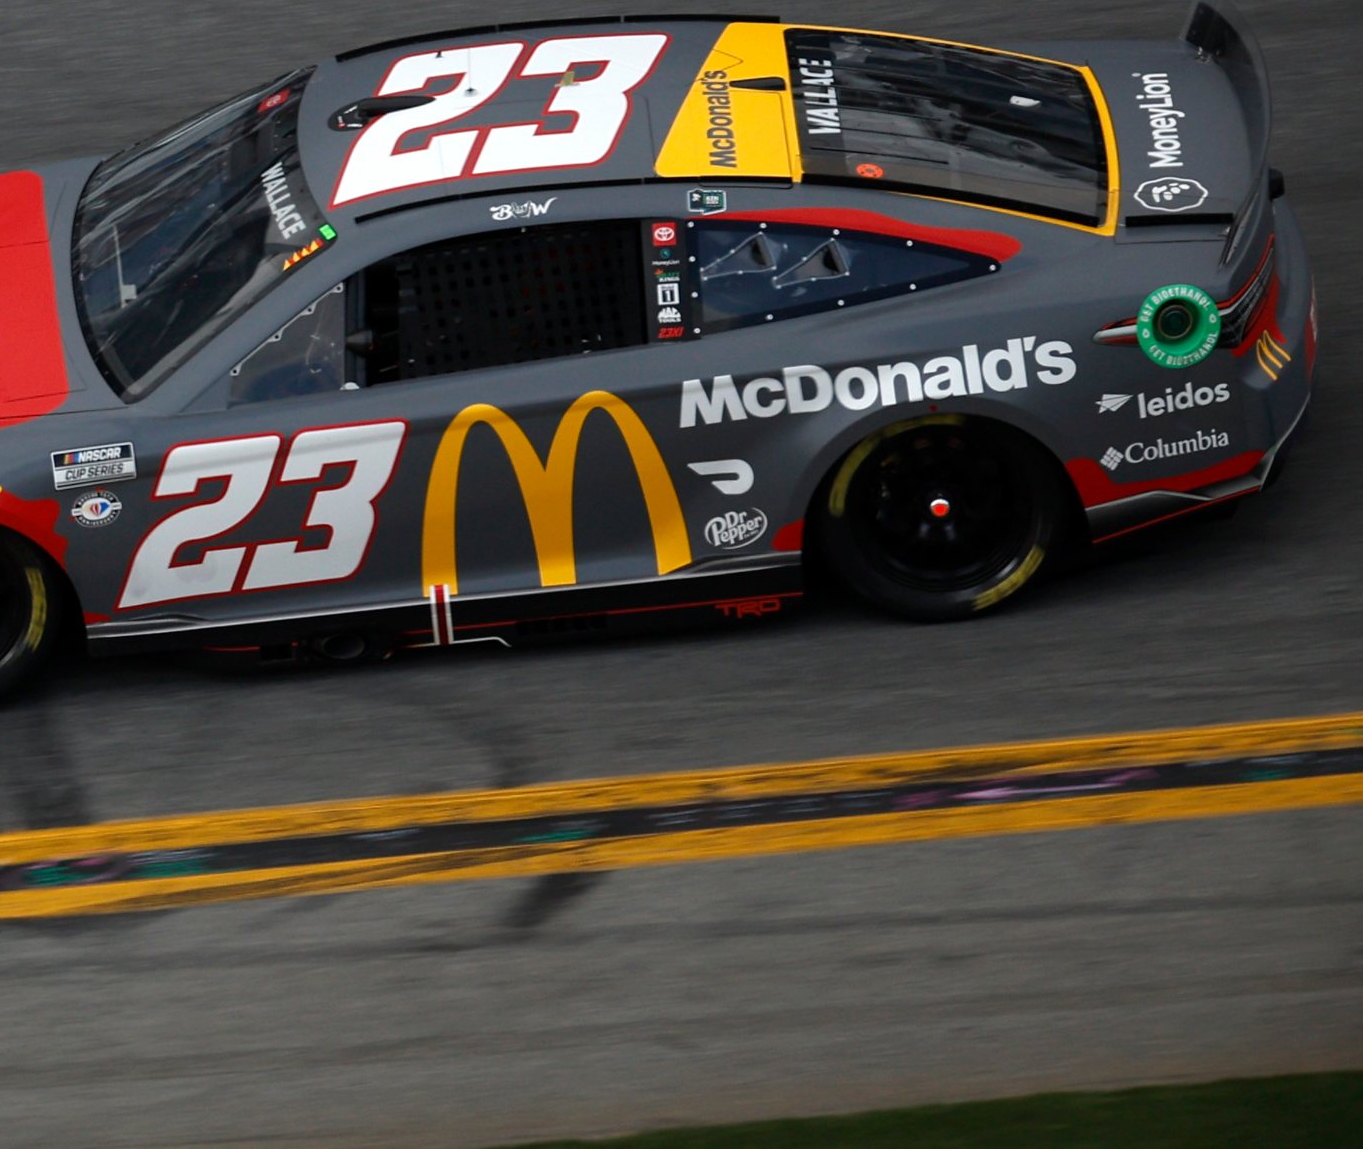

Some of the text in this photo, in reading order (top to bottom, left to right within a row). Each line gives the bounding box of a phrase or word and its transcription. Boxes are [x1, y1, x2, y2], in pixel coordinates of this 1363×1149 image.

[327, 32, 673, 210] 23
[700, 70, 738, 168] McDonald's
[1136, 73, 1185, 168] MoneyLion
[261, 161, 306, 240] WALLACE
[679, 336, 1077, 429] McDonald's
[1137, 381, 1231, 420] leidos
[65, 463, 124, 481] CUP SERIES
[79, 447, 122, 463] NASCAR
[1125, 429, 1230, 464] Columbia
[113, 418, 410, 611] 23
[710, 514, 763, 547] Pepper
[724, 510, 747, 528] Dr
